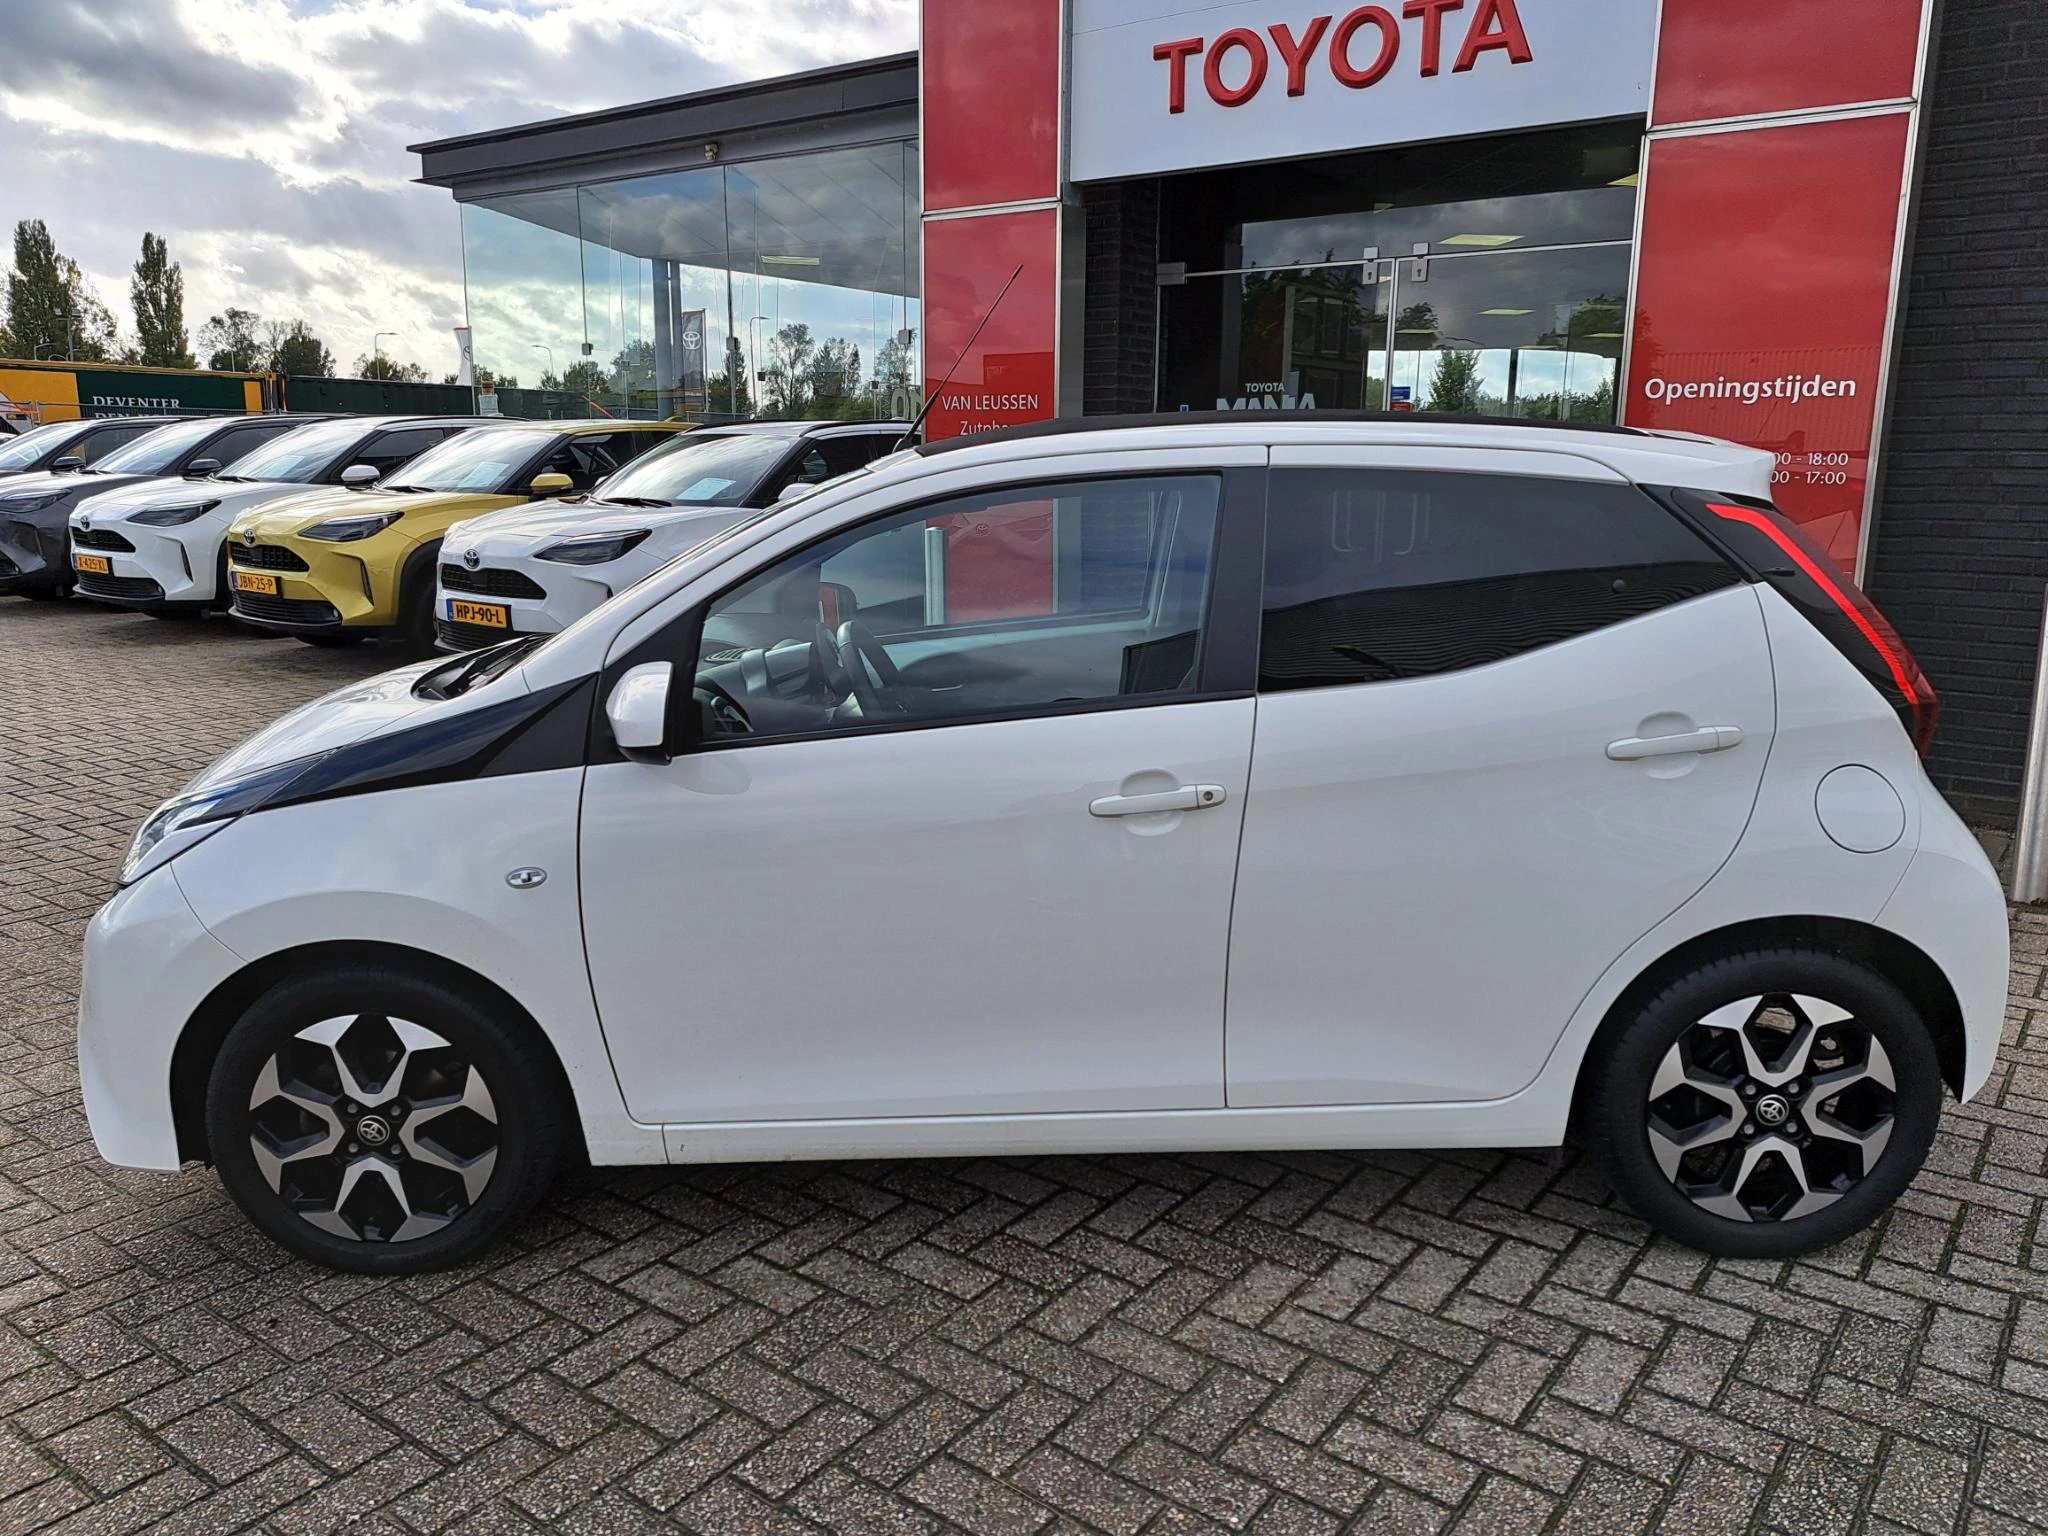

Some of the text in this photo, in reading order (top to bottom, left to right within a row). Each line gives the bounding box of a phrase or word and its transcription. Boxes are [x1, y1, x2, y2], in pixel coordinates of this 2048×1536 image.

[1153, 0, 1533, 114] TOYOTA
[1245, 382, 1285, 393] TOYOTA
[1644, 374, 1857, 405] Openingstijden
[92, 395, 180, 408] DEVENTER
[941, 395, 971, 410] VAN
[975, 394, 1039, 410] LEUSSEN
[1807, 452, 1849, 466] 18:00
[1805, 471, 1847, 485] 17:00
[239, 574, 273, 591] JBN-25-P
[455, 603, 503, 624] HPJ-90-L
